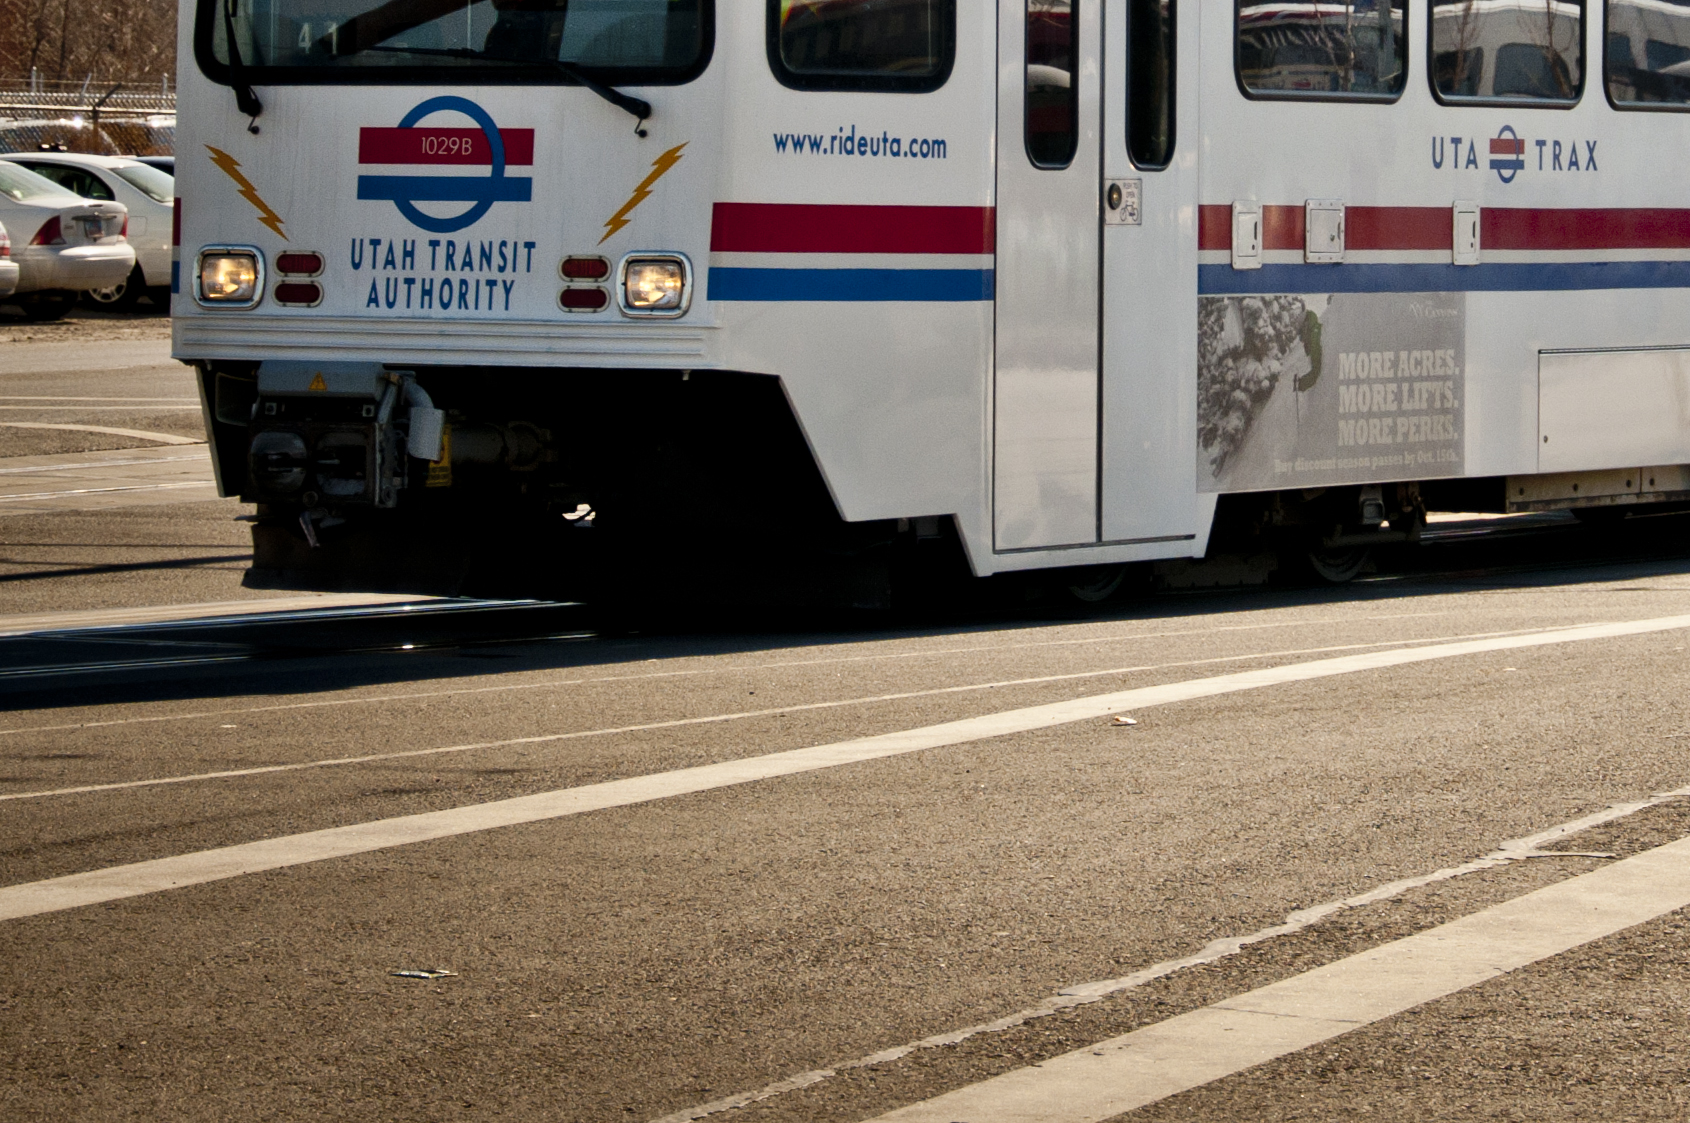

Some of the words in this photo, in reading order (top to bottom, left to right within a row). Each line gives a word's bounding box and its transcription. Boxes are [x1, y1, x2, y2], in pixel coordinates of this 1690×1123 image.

[421, 136, 473, 156] 1029B
[772, 124, 948, 159] www.rideuta.com
[1431, 135, 1479, 170] UTA
[1534, 139, 1599, 172] TRAX
[351, 238, 416, 271] UTAH
[428, 239, 536, 274] TRANSIT
[365, 277, 515, 311] AUTHORITY
[1339, 351, 1395, 380] MORE
[1397, 348, 1460, 378] ACRES.
[1338, 382, 1398, 414] MORE
[1401, 380, 1459, 411] LIFTS.
[1338, 417, 1395, 447] MORE
[1396, 413, 1459, 444] PERKS.
